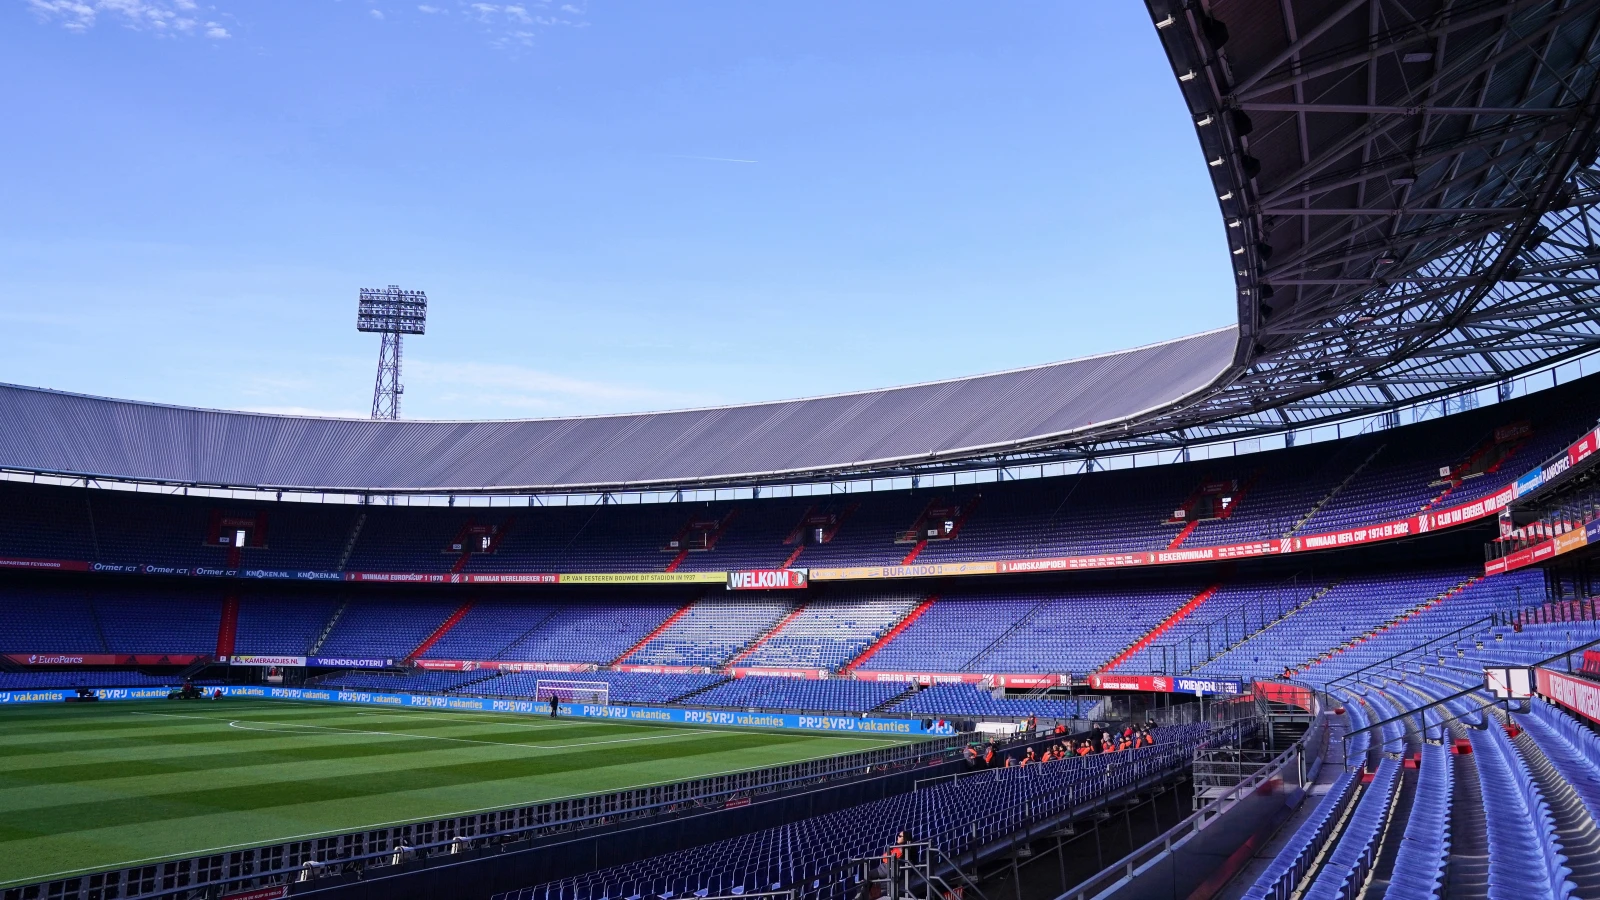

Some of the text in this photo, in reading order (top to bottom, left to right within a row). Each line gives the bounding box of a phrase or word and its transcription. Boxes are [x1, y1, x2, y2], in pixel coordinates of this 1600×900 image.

[1437, 513, 1451, 526] CLUB
[1306, 522, 1409, 548] WINNAAR UEFA CUP 1974 EN 2002
[1158, 549, 1213, 562] BEKERWINNAAR
[94, 562, 123, 571] Ormer
[146, 565, 174, 573] Ormer
[1009, 560, 1066, 571] LANDSKAMPIOEN
[196, 567, 223, 576] Ormer
[246, 570, 289, 578] KNAKEN.NL
[297, 571, 339, 579] KNAKEN.NL
[883, 566, 936, 577] BURANDO
[730, 571, 789, 588] WELKOM
[38, 655, 83, 664] EuroParcs
[244, 657, 299, 665] KAMERAADJES.NL
[318, 658, 384, 667] VRIENDENLOTERIJ
[877, 673, 904, 682] GERARD
[14, 691, 63, 701] vakanties
[131, 688, 170, 697] vakanties
[231, 687, 265, 696] vakanties
[302, 690, 331, 700] vakanties
[373, 694, 402, 704] vakanties
[449, 699, 483, 709] vakanties
[631, 710, 671, 721] vakanties
[737, 714, 784, 726] vakanties
[857, 720, 910, 733] vakanties
